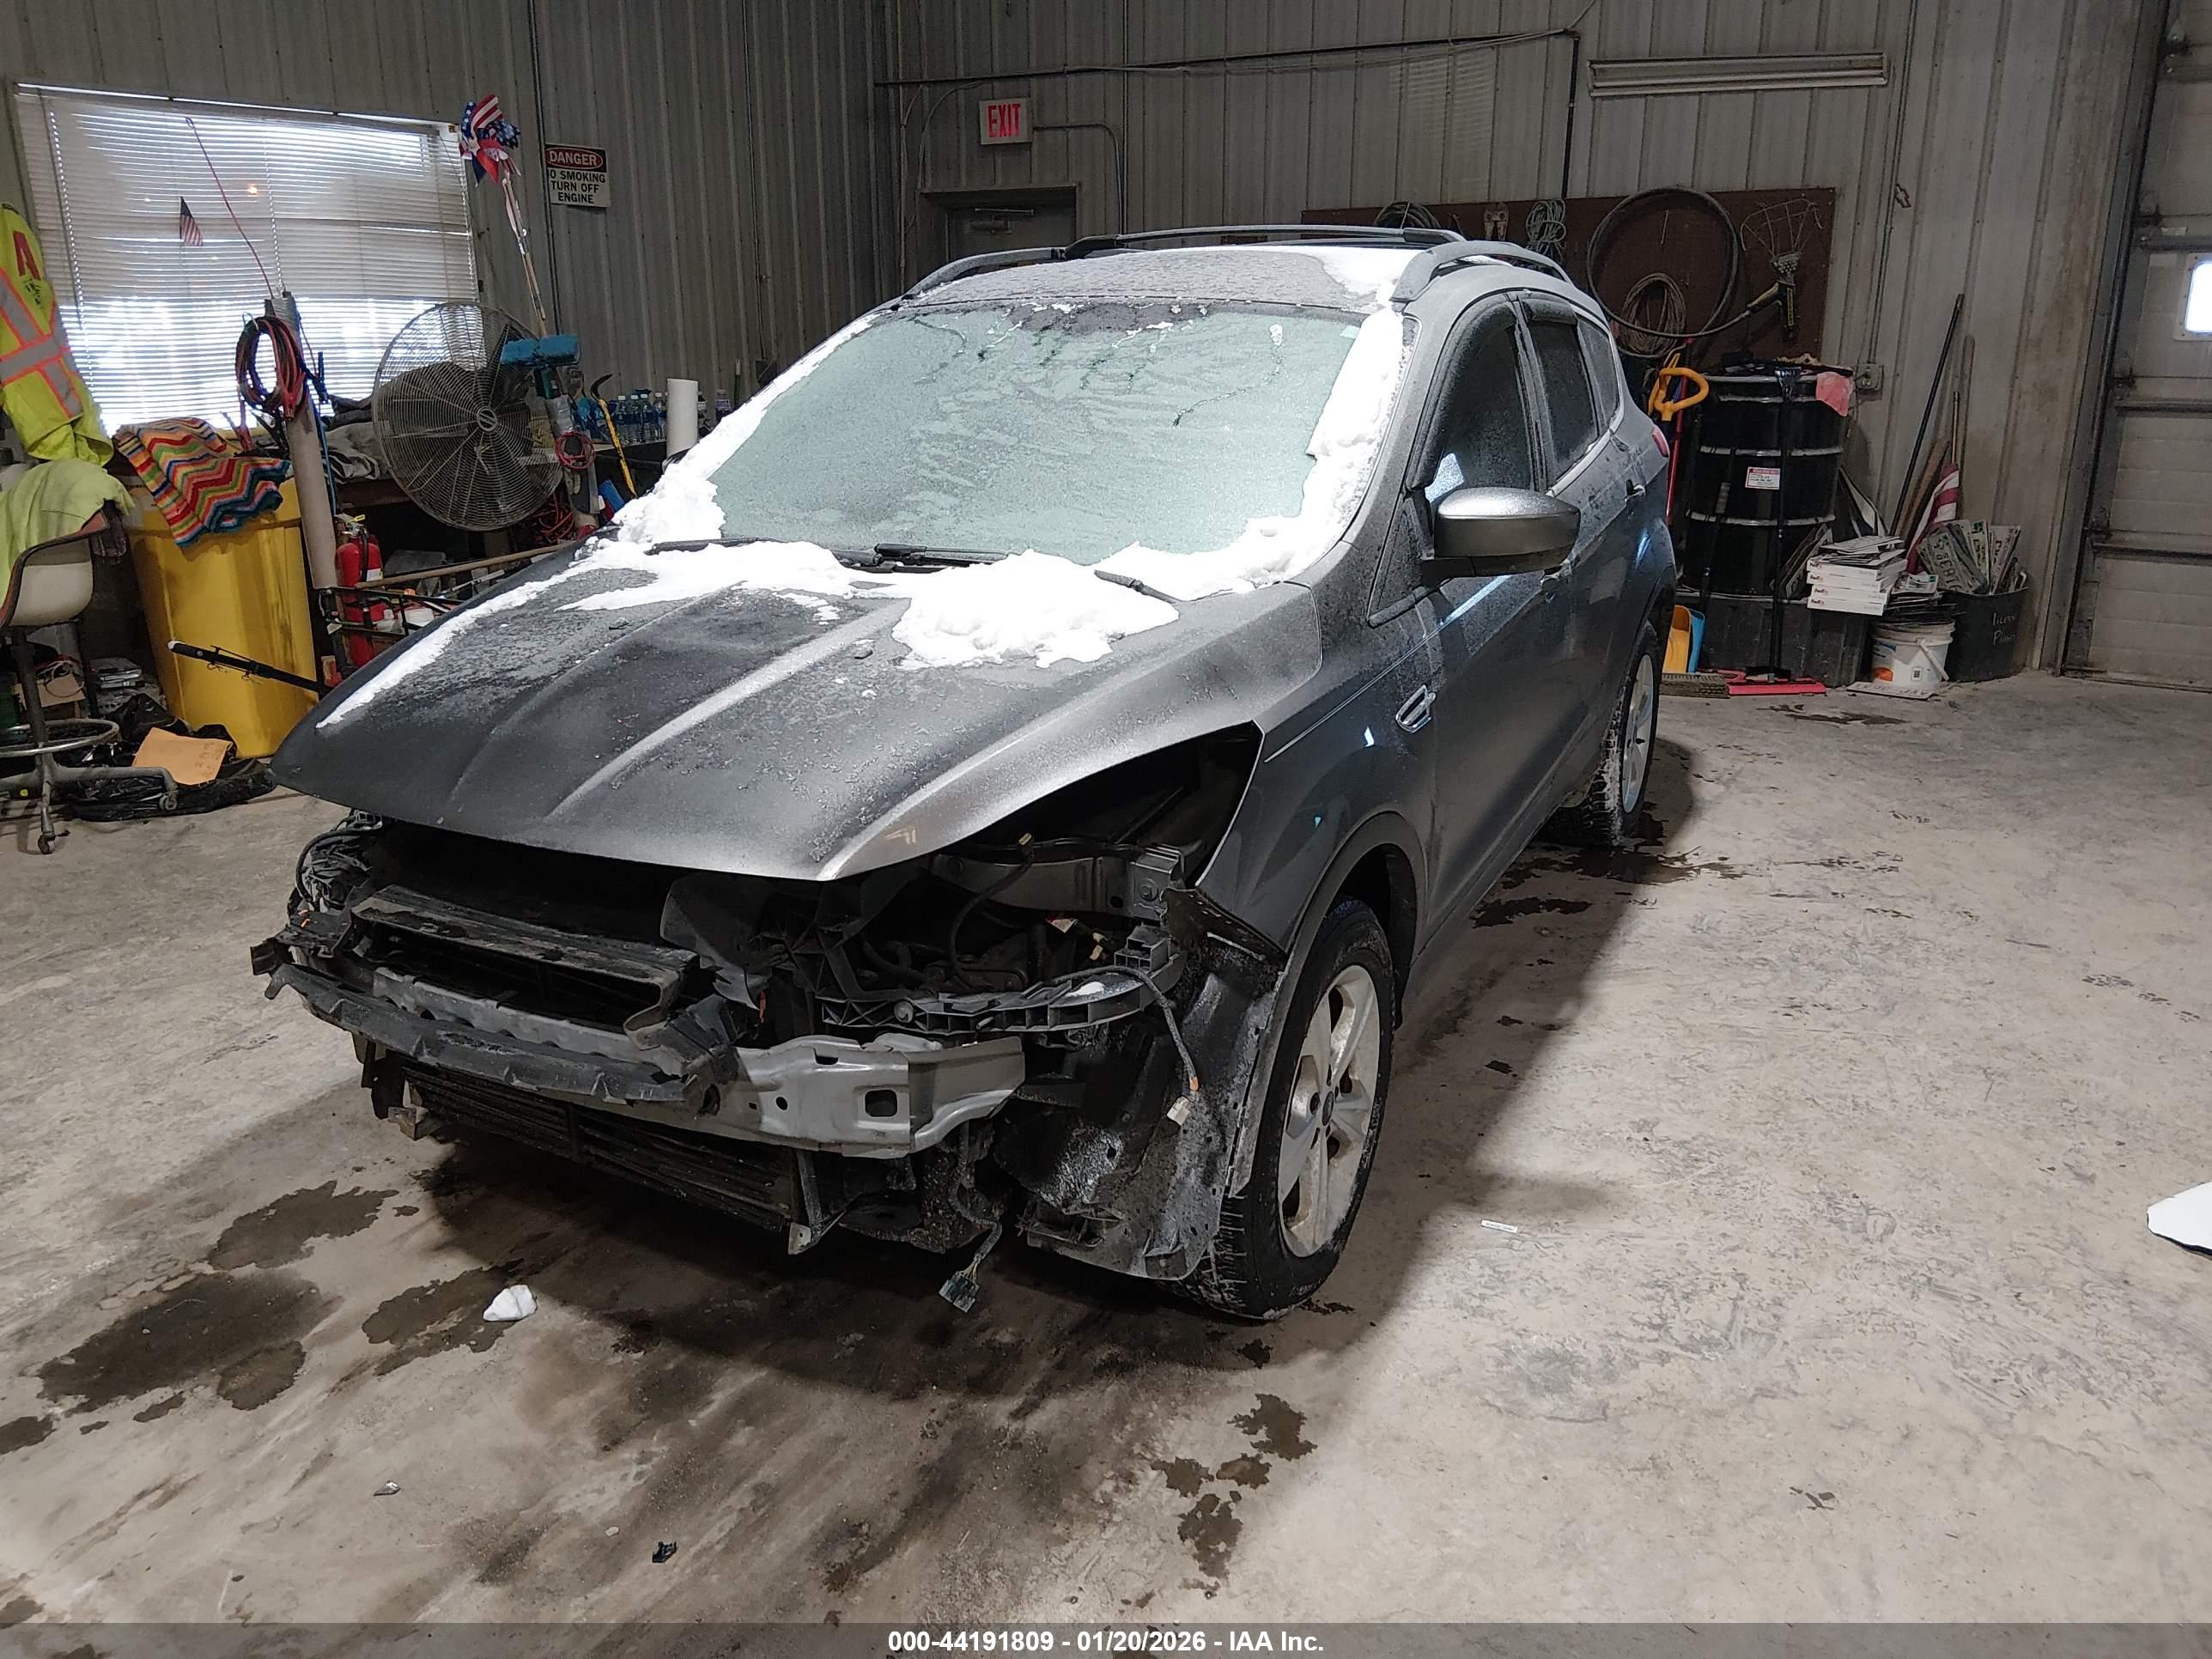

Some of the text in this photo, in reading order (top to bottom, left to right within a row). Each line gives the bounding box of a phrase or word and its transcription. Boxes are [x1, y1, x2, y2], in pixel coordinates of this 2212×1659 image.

[988, 104, 1021, 137] EXIT
[550, 150, 598, 166] DANGER
[550, 169, 606, 184] O SMOKING
[550, 180, 600, 193] TURN OFF
[557, 191, 594, 204] ENGINE
